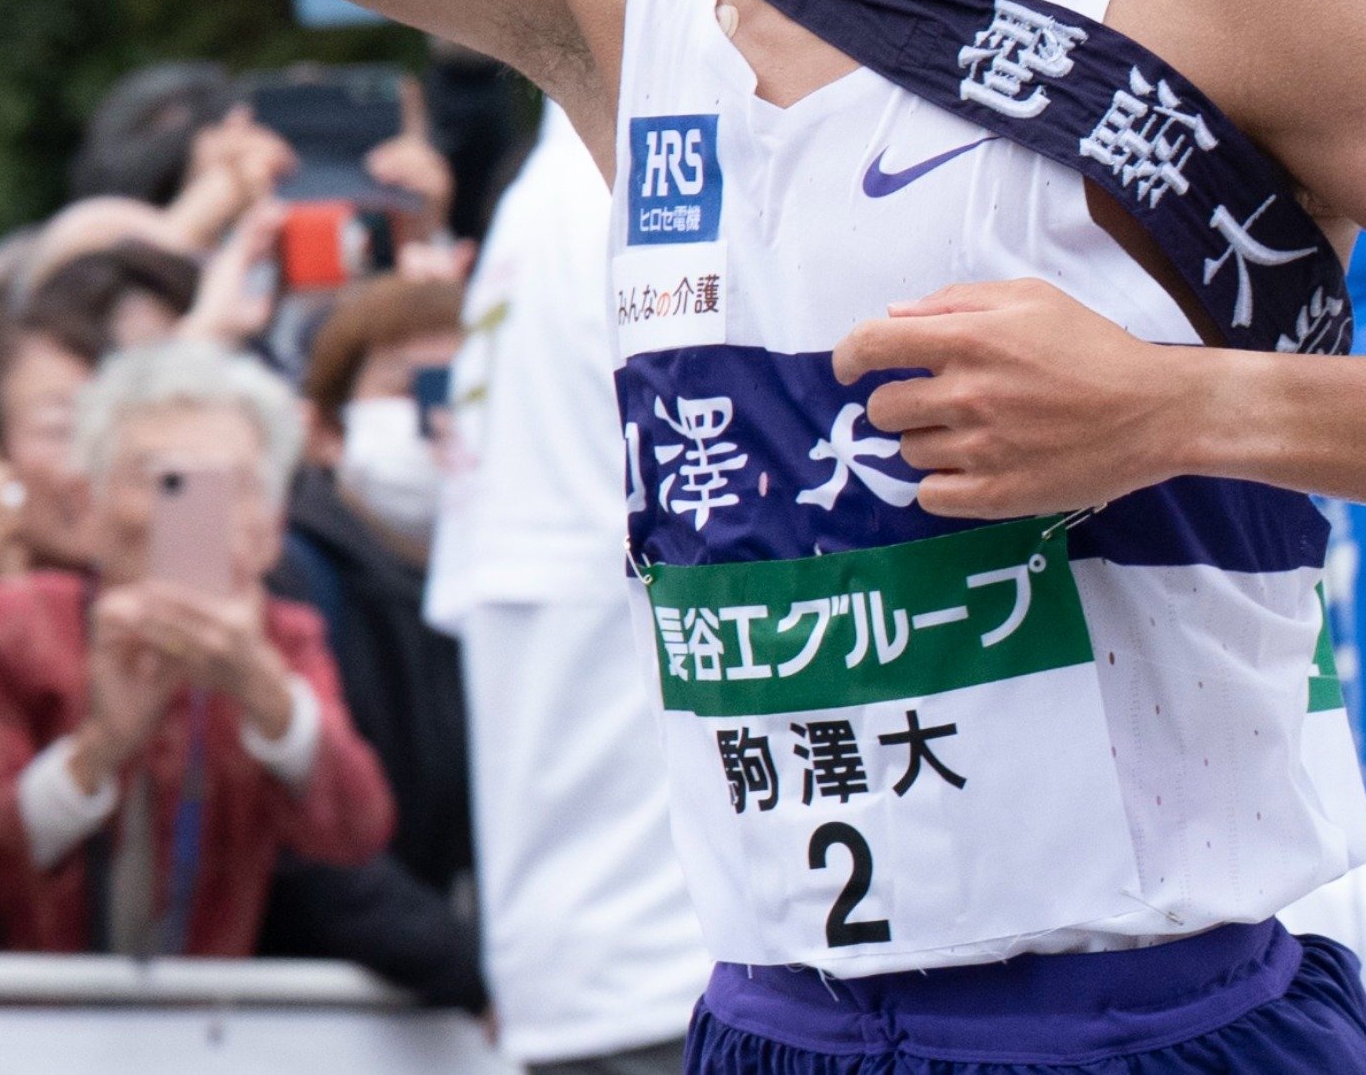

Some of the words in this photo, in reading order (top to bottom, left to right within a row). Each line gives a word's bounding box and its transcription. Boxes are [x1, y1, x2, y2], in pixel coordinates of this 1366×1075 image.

[641, 128, 704, 198] HRS
[639, 204, 702, 232] ヒロセ電機
[617, 274, 720, 326] みんなの介護
[625, 395, 920, 532] 澤大
[654, 553, 1047, 682] 長谷工グループ
[716, 709, 968, 815] 駒澤大
[807, 821, 892, 949] 2
